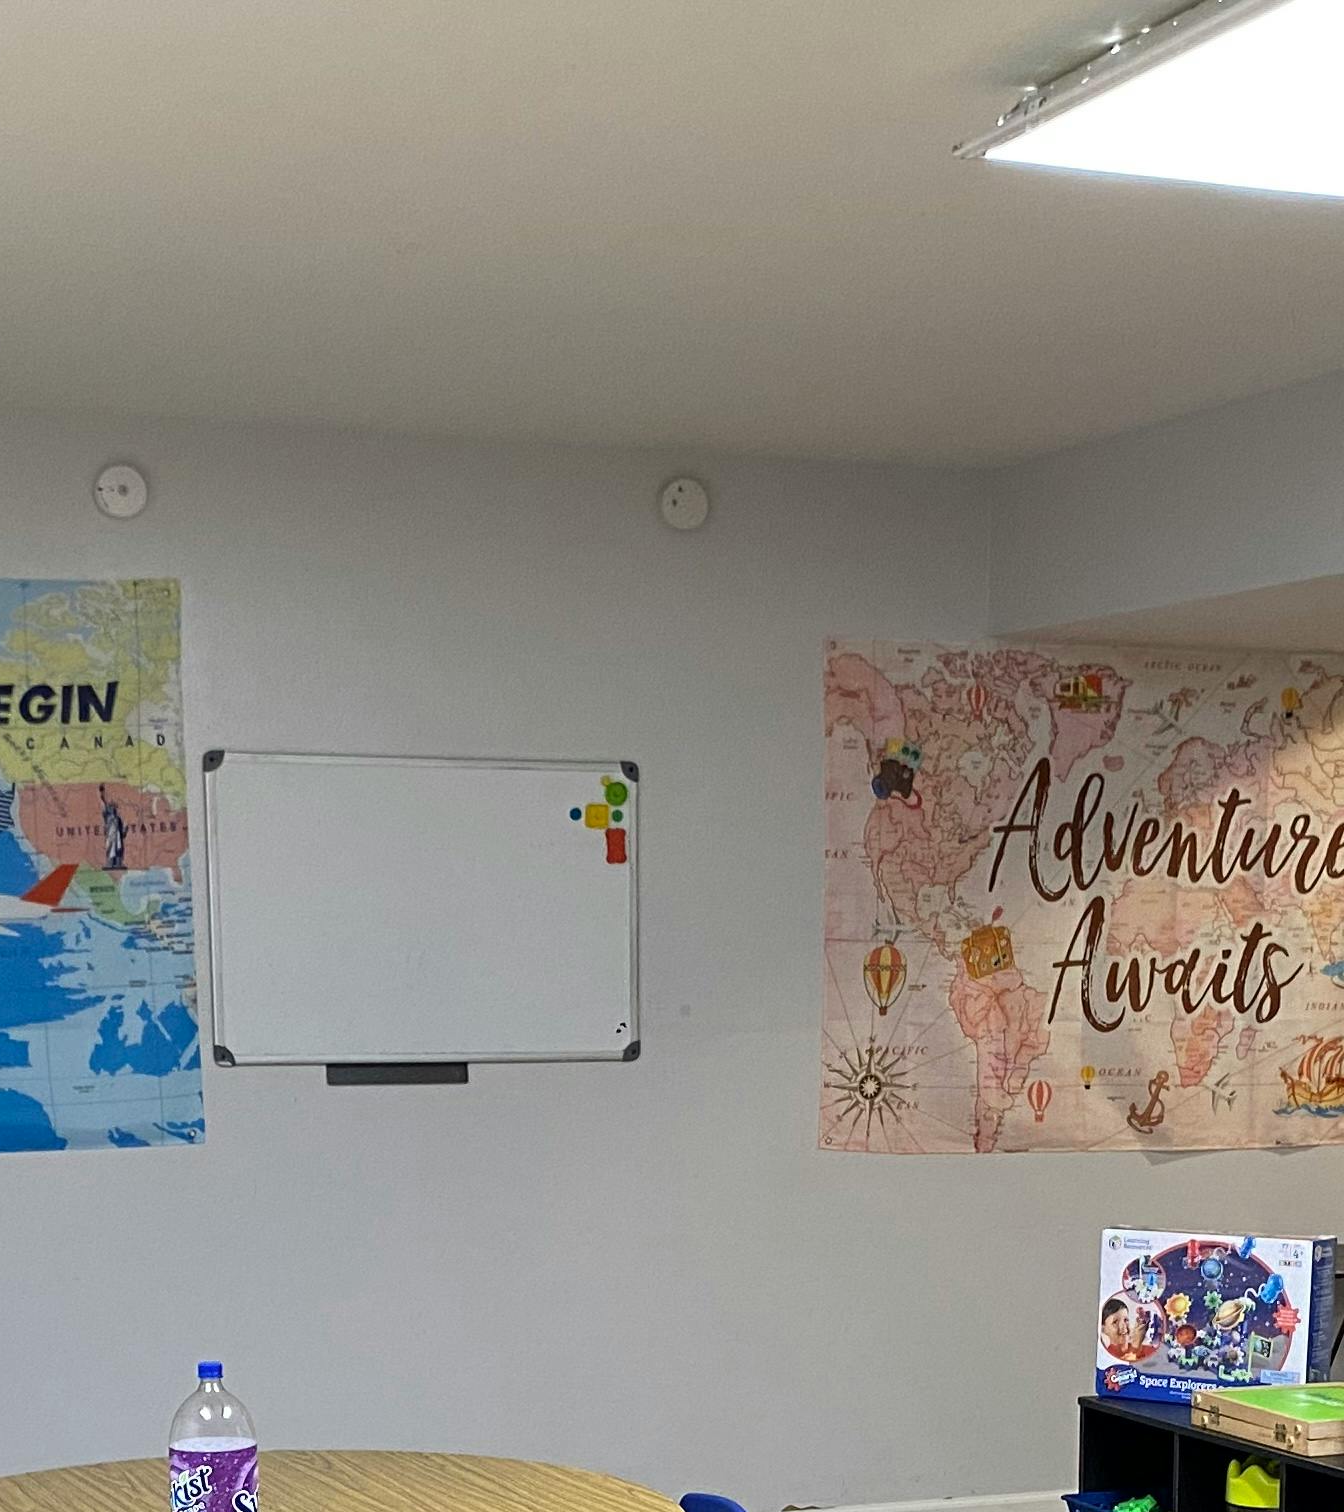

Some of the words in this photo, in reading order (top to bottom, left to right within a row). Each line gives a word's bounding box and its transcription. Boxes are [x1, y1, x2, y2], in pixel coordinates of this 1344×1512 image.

[1046, 895, 1306, 1034] Awaits
[1139, 1374, 1169, 1390] Space
[1169, 1377, 1218, 1394] Explorers
